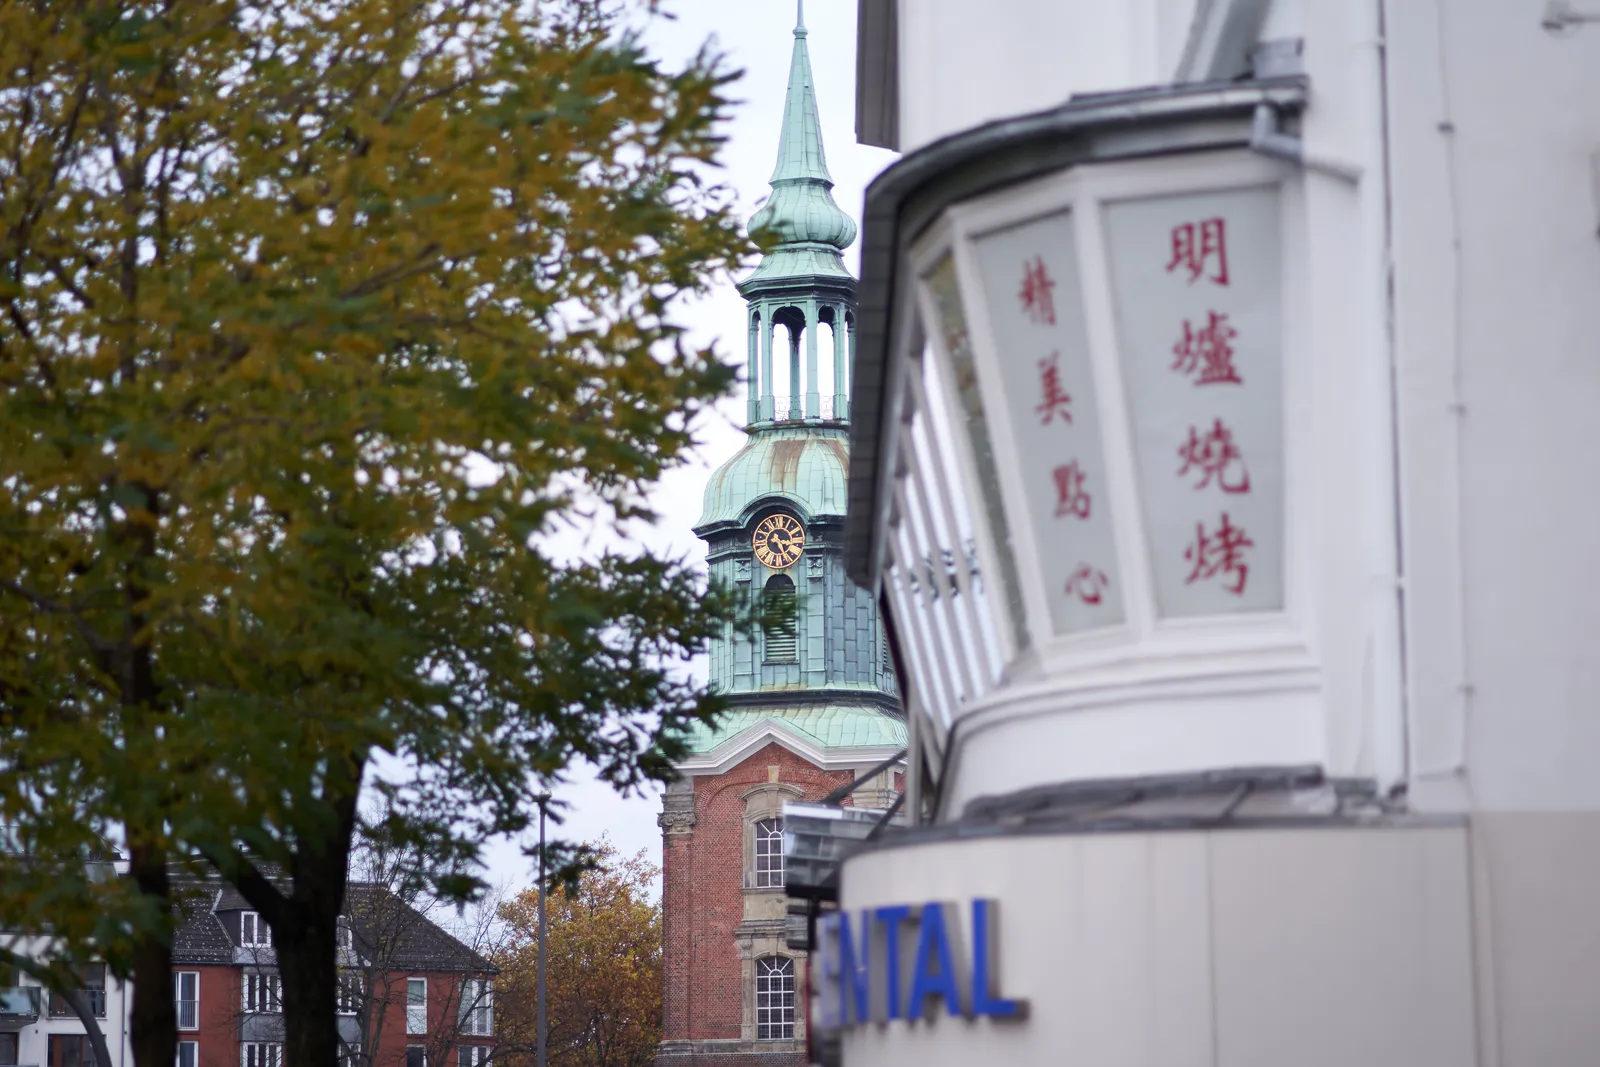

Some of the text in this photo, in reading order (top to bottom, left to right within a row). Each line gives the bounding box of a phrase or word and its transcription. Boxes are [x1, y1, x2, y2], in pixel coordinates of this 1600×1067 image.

[1018, 254, 1109, 605] 精美點心
[1167, 217, 1254, 597] 明爐燒烤
